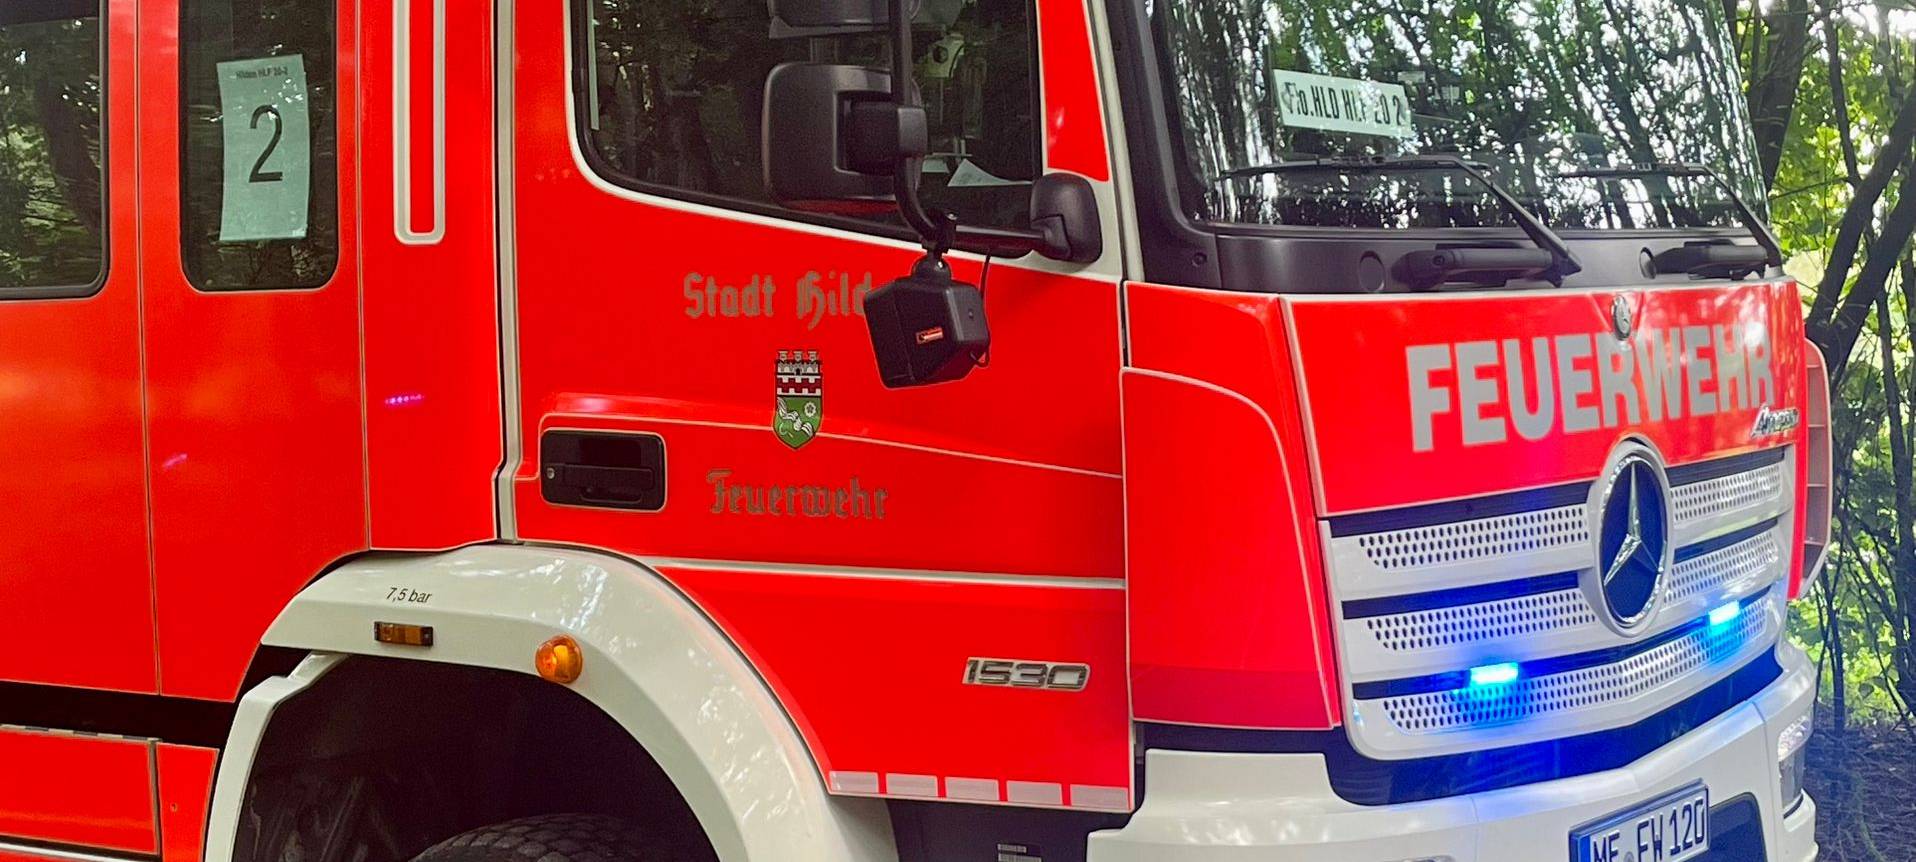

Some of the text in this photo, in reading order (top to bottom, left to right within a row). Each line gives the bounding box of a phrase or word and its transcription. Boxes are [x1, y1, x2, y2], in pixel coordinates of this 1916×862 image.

[249, 104, 283, 183] 2
[683, 270, 873, 331] Stadt Hild
[1405, 322, 1776, 452] FEUERWEHR
[706, 468, 888, 519] Feuerwehr
[386, 586, 432, 603] 7,5 bar
[964, 657, 1089, 691] 1530
[1637, 812, 1665, 862] FW
[1669, 796, 1705, 857] 120
